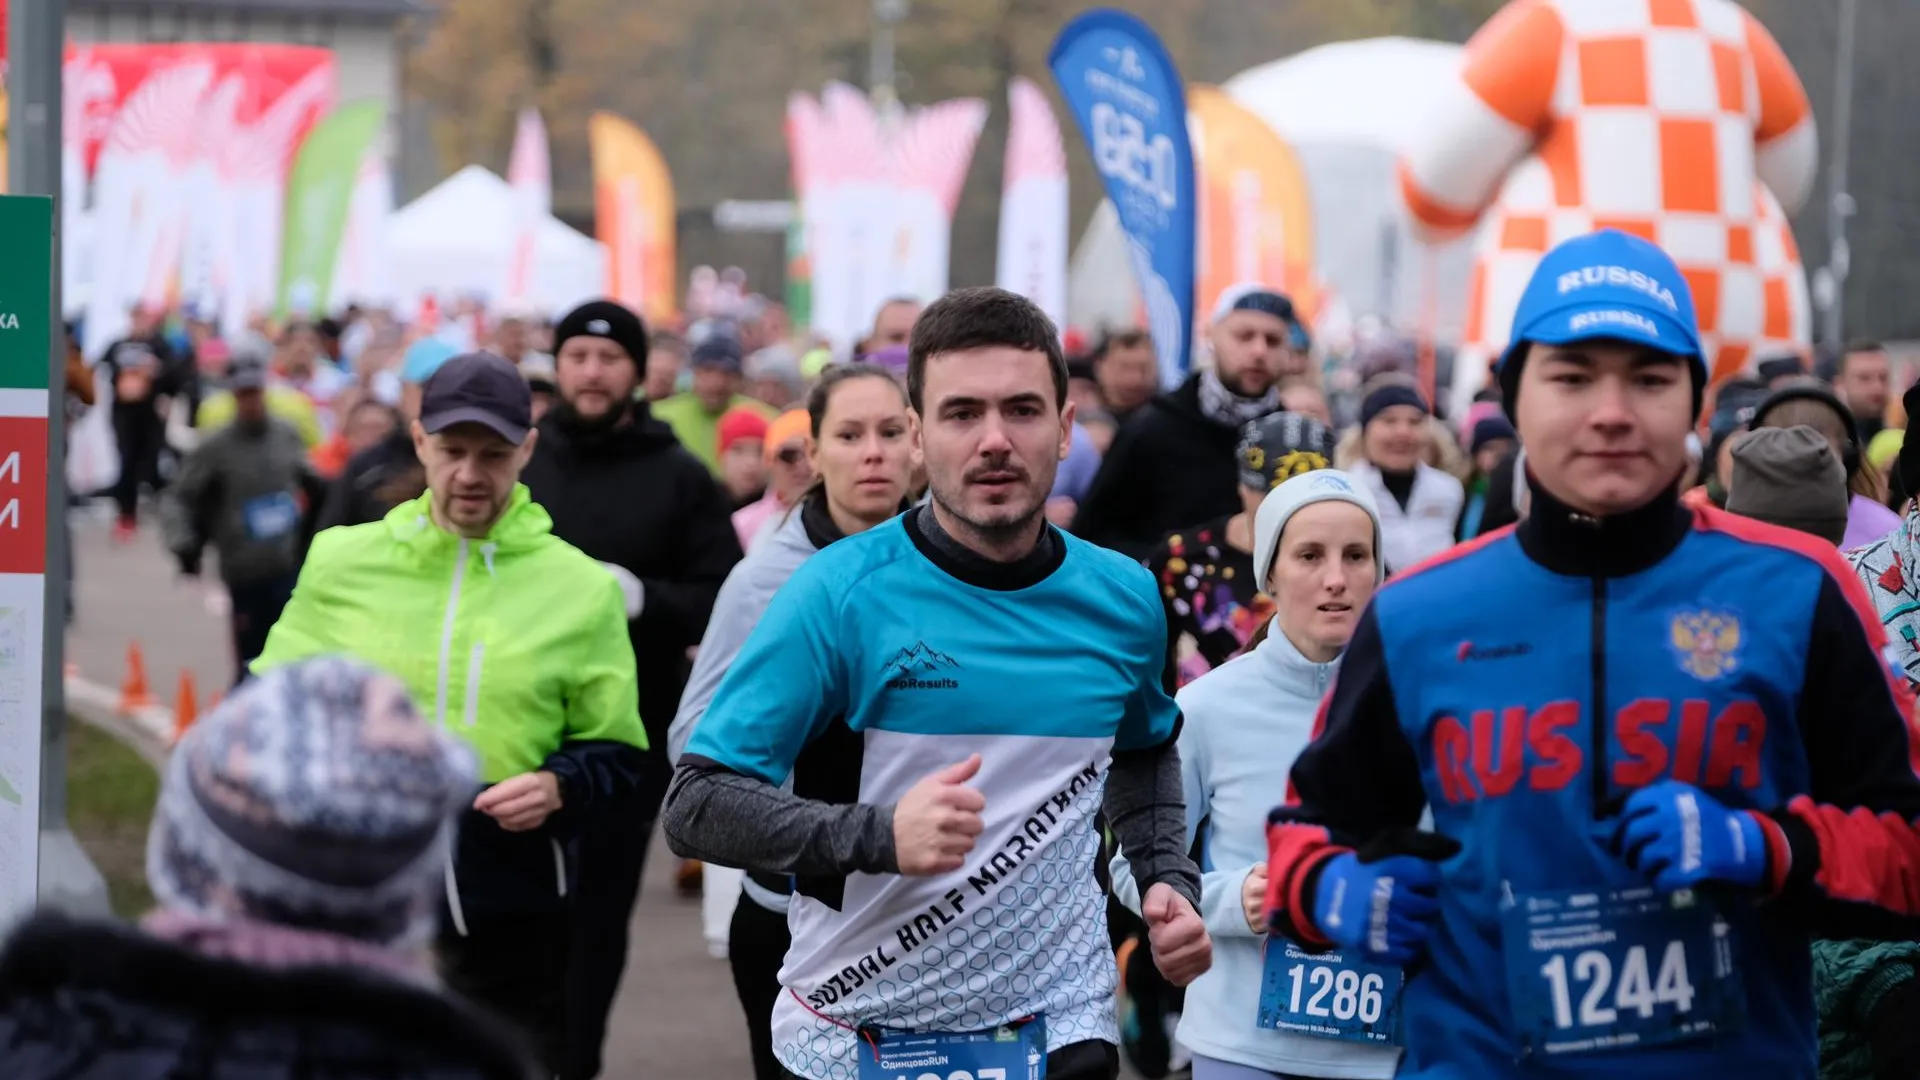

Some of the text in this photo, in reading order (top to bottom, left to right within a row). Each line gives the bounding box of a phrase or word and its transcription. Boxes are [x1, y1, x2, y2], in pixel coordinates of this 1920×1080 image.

[1557, 265, 1679, 312] RUSSIA
[1569, 310, 1659, 336] RUSSIA
[807, 761, 1099, 1010] SUZDAL HALF MARATHON
[1288, 964, 1384, 1024] 1286
[1540, 940, 1695, 1029] 1244
[881, 1055, 949, 1070] ОдинцовоRUN
